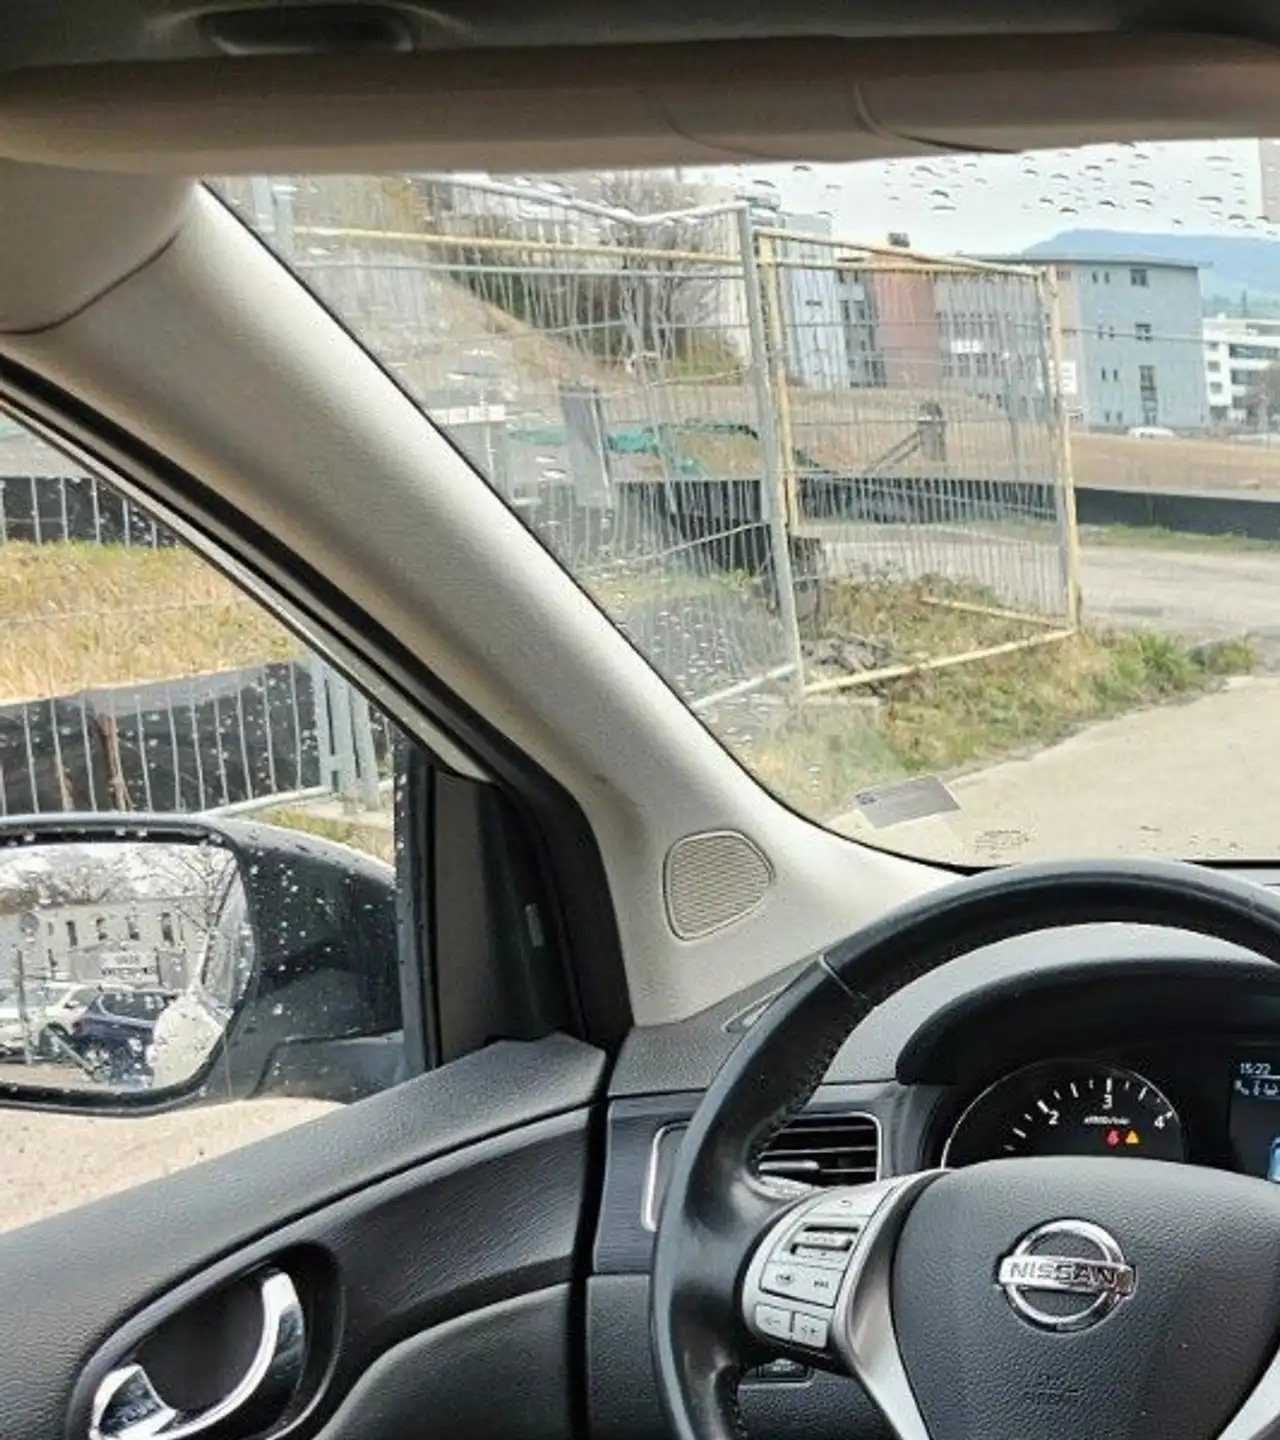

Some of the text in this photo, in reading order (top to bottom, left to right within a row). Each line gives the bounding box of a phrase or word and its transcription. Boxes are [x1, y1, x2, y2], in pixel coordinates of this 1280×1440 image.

[1103, 1094, 1113, 1110] 3
[1048, 1110, 1059, 1125] 2
[1154, 1115, 1166, 1130] 4
[1010, 1262, 1115, 1283] NISSAN
